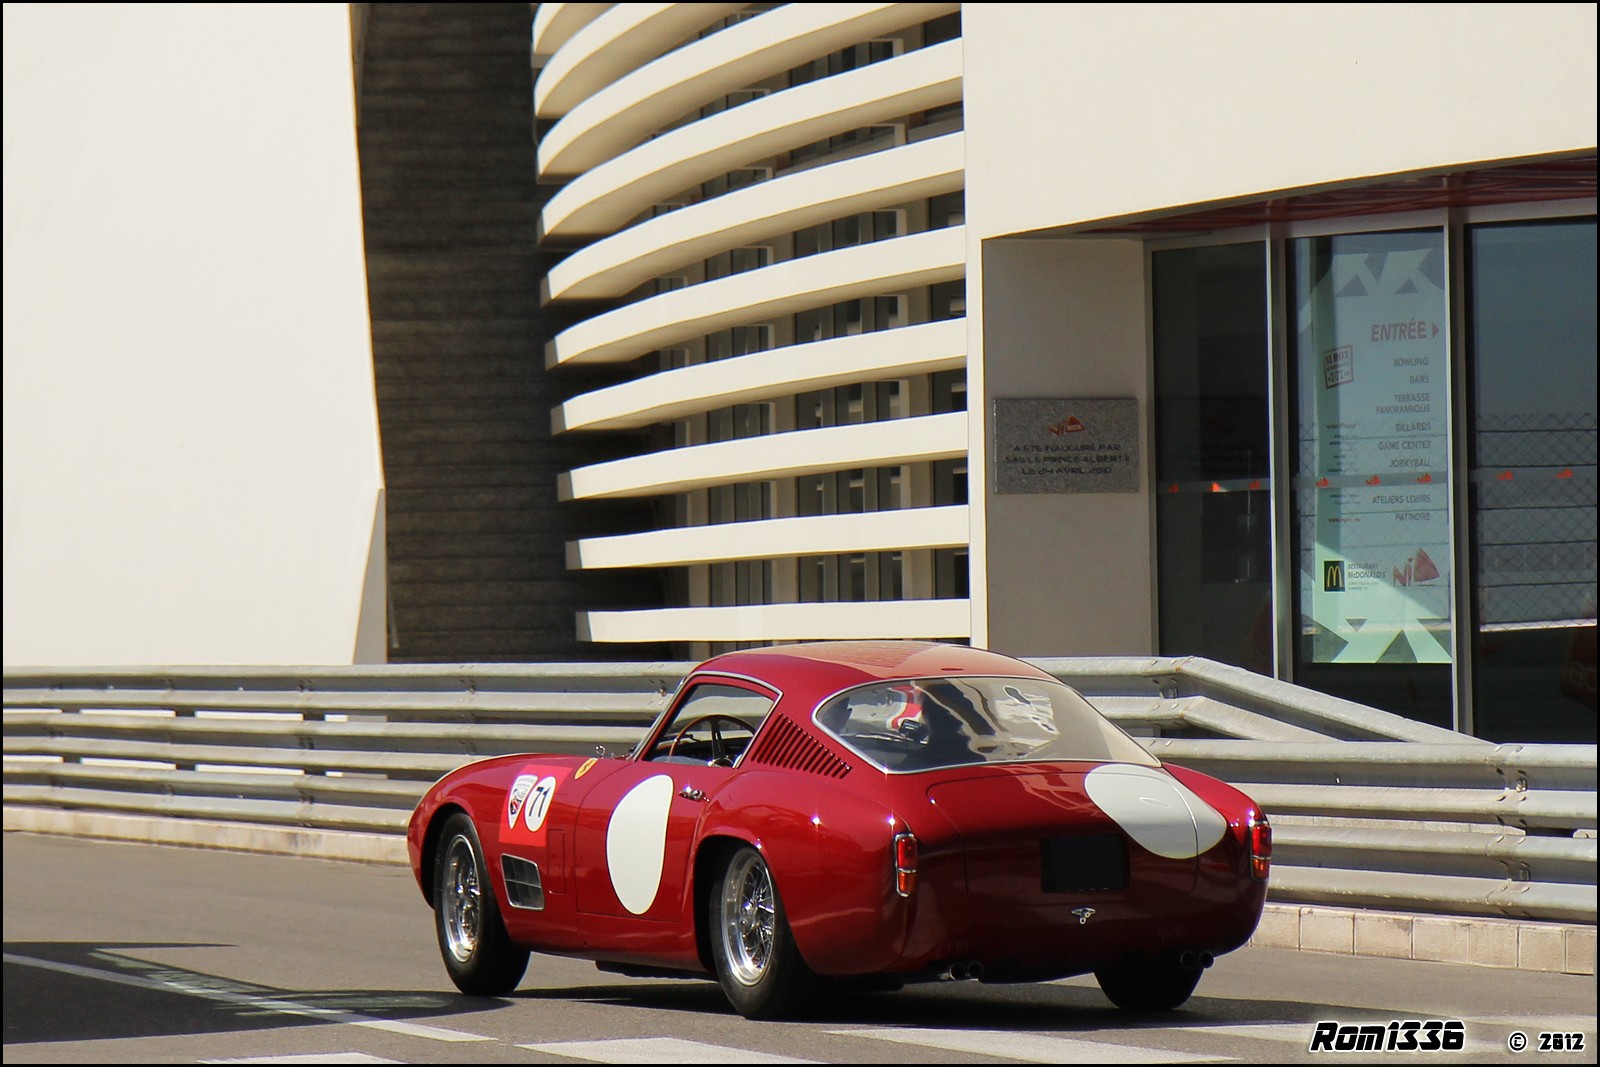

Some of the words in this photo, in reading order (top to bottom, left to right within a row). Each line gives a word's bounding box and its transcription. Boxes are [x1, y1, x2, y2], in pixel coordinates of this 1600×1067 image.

[1371, 318, 1427, 342] ENTRÉE
[1394, 357, 1429, 367] BOWLING
[1410, 375, 1430, 384] BARS
[1394, 393, 1431, 402] TERRASSE
[1376, 404, 1431, 415] PANORAMIQUE
[1395, 422, 1432, 432] BILLARDS
[1099, 443, 1121, 452] PAR
[1378, 442, 1400, 450] GAME
[1402, 440, 1432, 449] CENTER
[1082, 455, 1123, 463] ALBERT
[1390, 459, 1431, 468] JORKYBALL
[1372, 496, 1404, 505] ATELIERS
[1406, 495, 1431, 504] LOISIRS
[1396, 513, 1431, 522] PATINOIRE
[529, 787, 551, 818] 71
